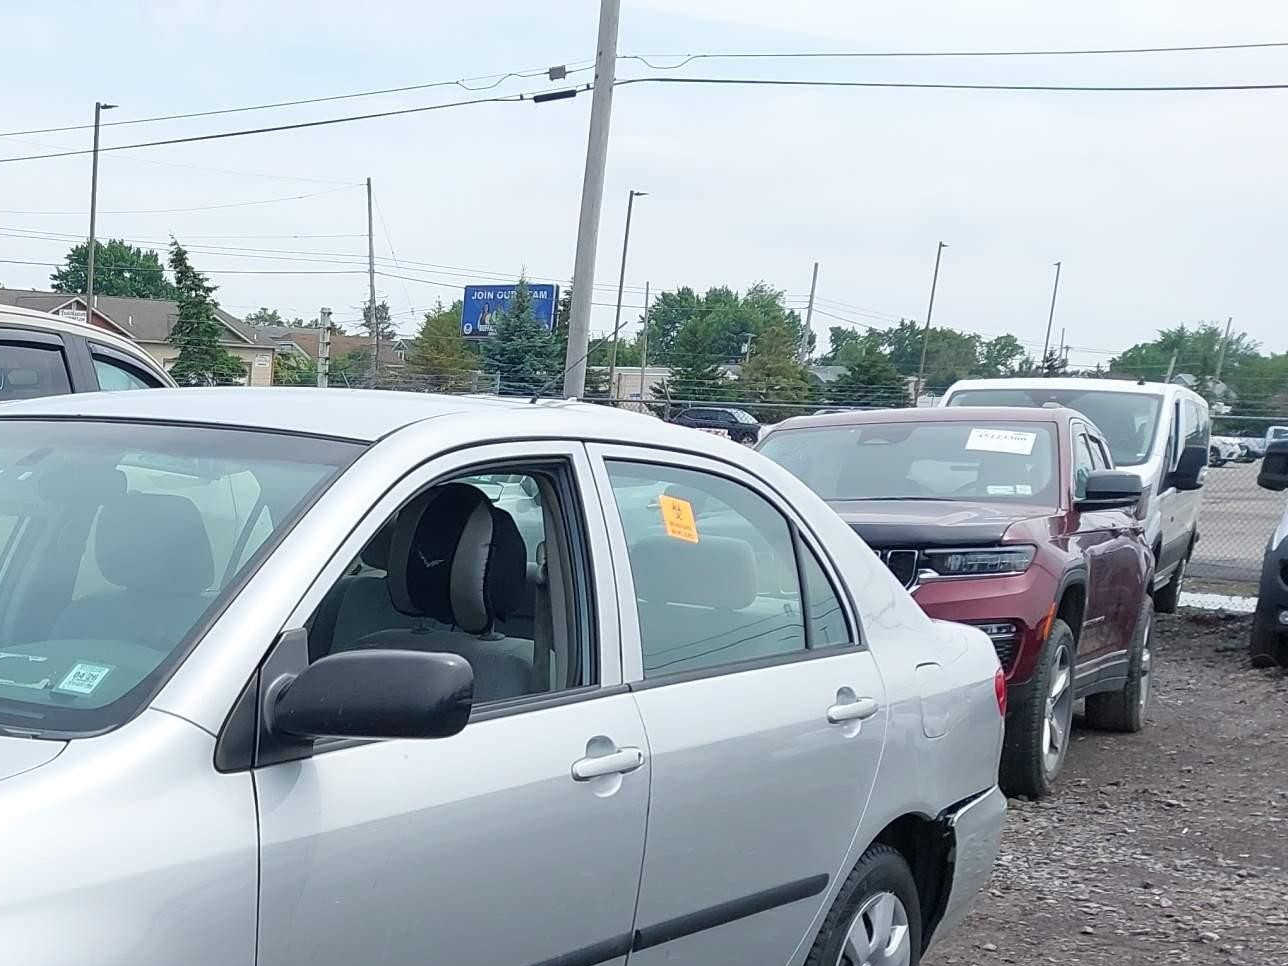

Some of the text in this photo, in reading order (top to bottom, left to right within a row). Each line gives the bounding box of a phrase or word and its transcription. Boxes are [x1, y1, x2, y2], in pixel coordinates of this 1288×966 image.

[472, 290, 548, 300] JOIN OUR EAM
